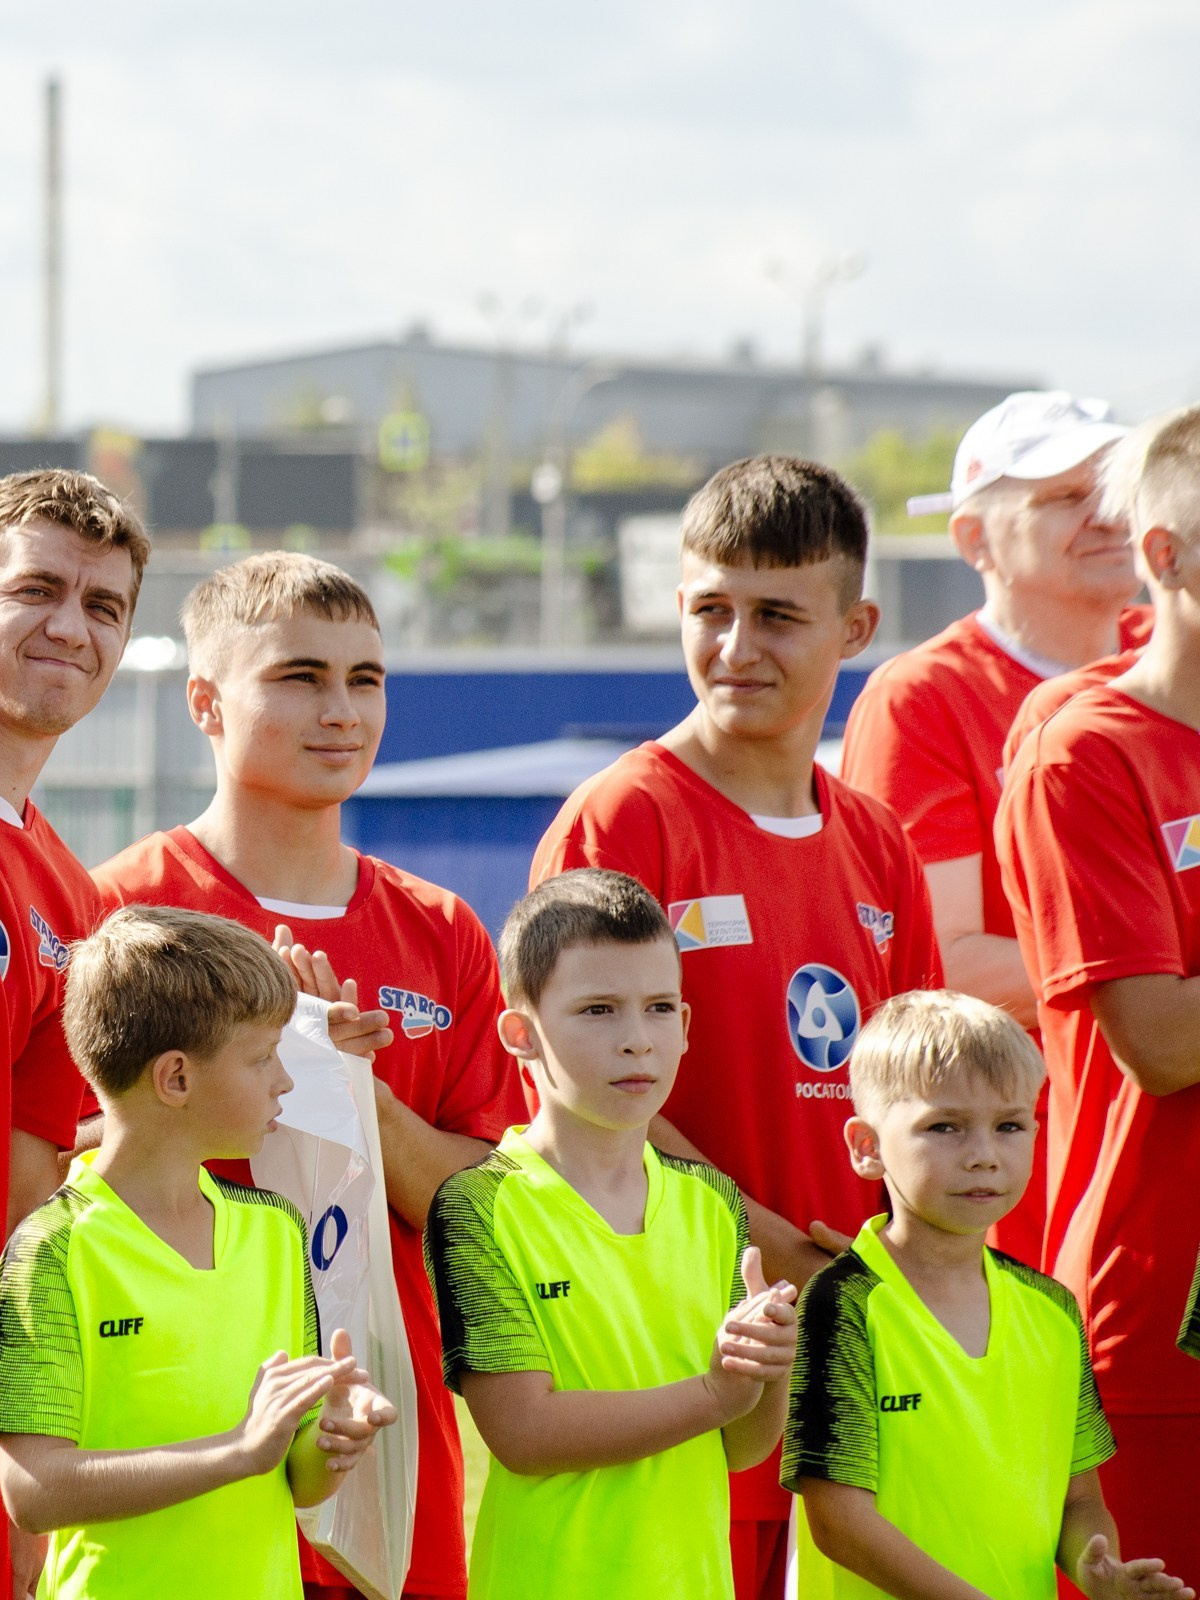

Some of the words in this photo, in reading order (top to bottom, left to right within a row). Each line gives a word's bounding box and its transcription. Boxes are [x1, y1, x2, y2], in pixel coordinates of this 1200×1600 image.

[380, 987, 451, 1028] STARCO
[99, 1317, 144, 1338] CLIFF
[880, 1393, 922, 1412] CLIFF
